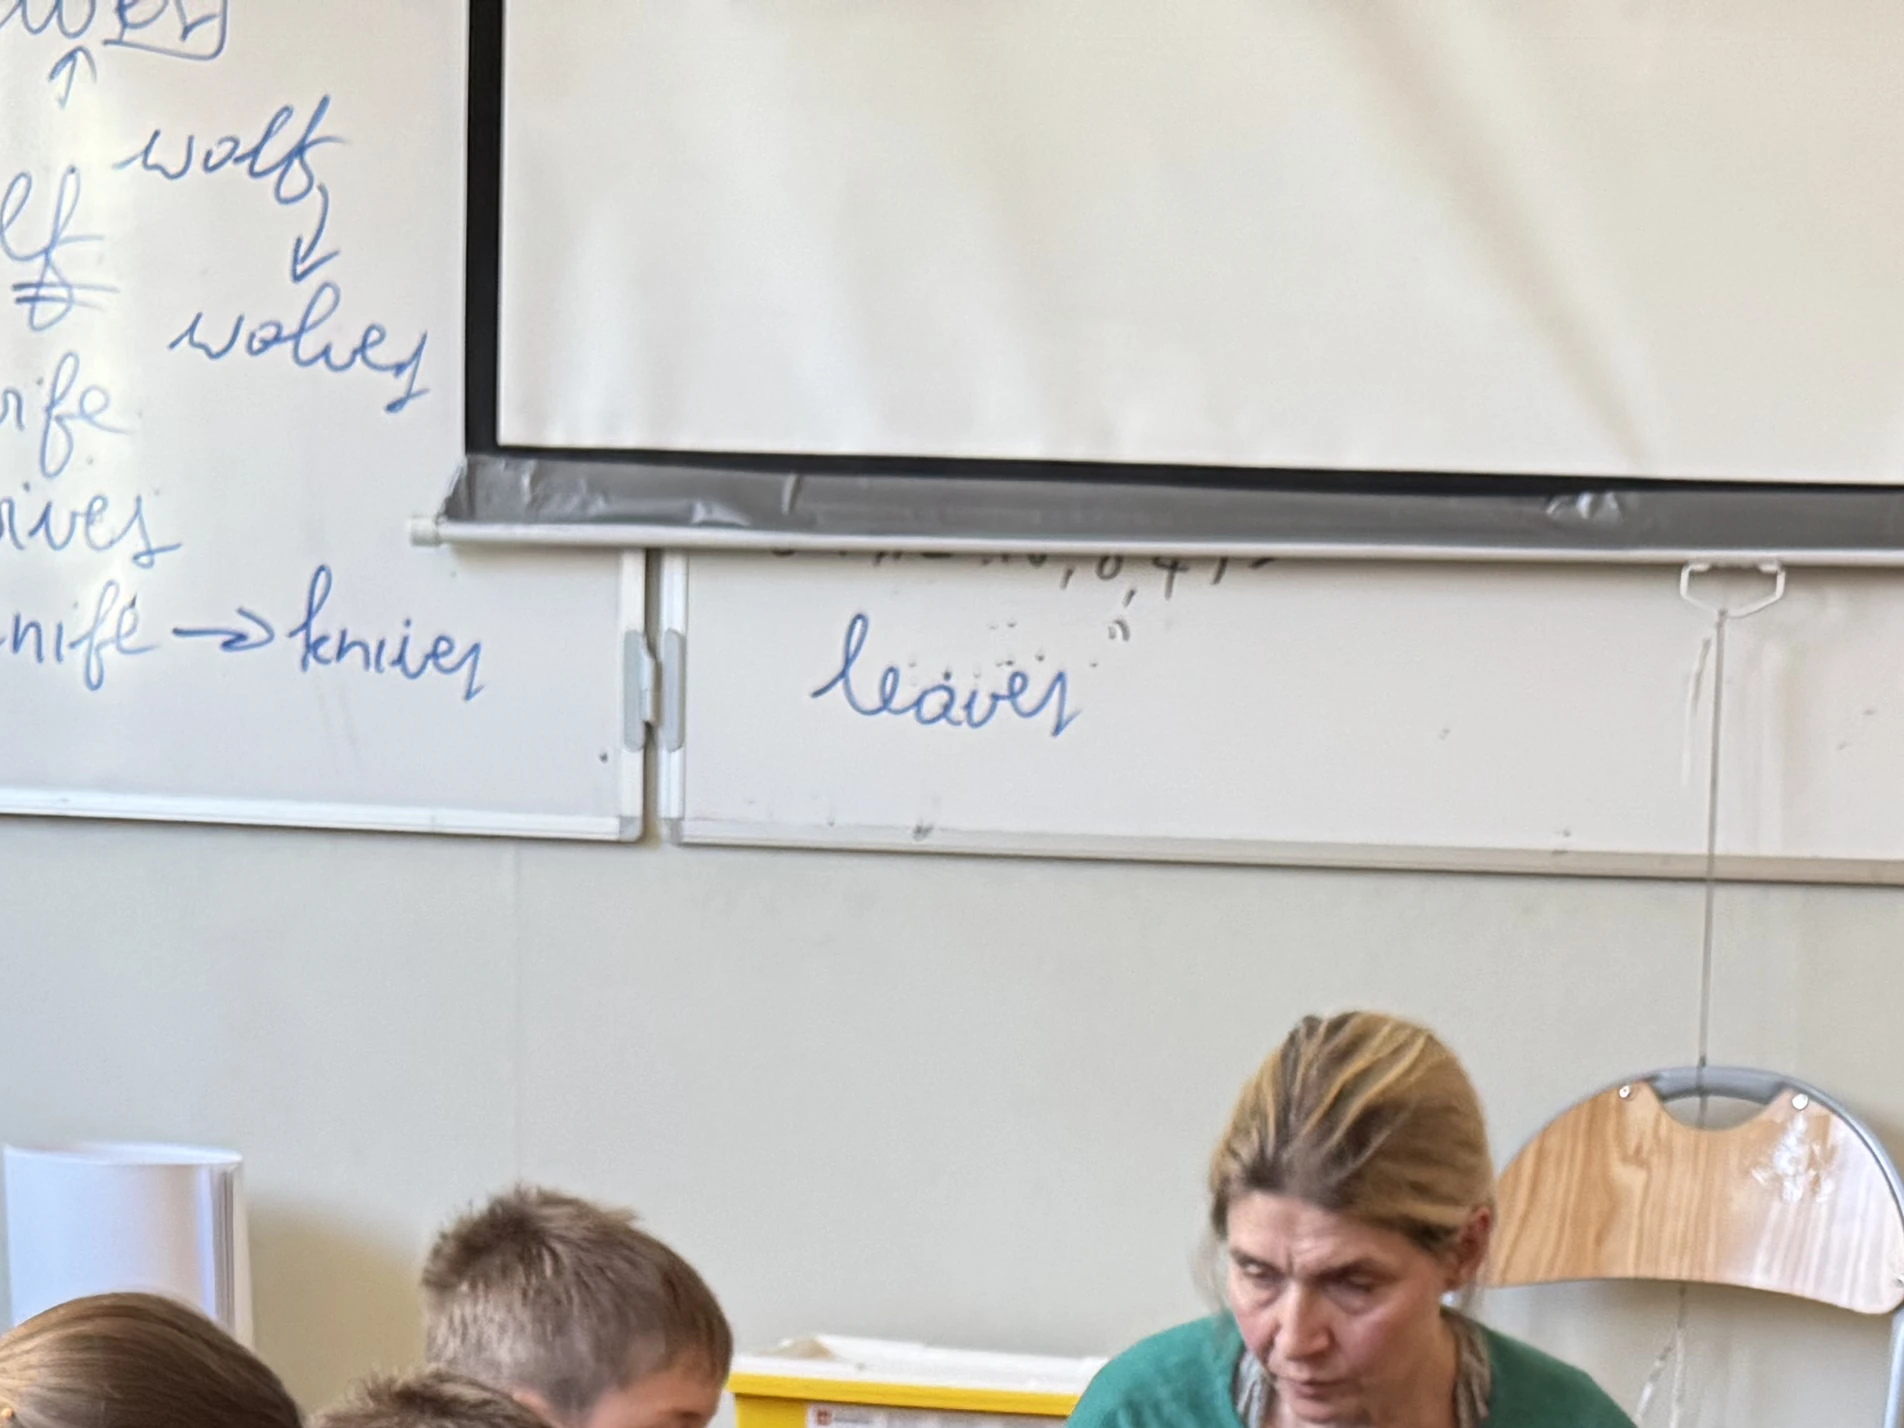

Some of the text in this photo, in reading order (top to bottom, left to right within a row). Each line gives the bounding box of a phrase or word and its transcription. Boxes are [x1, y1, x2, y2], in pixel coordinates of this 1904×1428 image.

[112, 94, 350, 205] wolf
[167, 282, 431, 413] wolves
[287, 564, 485, 702] knives
[811, 612, 1082, 738] leaves
